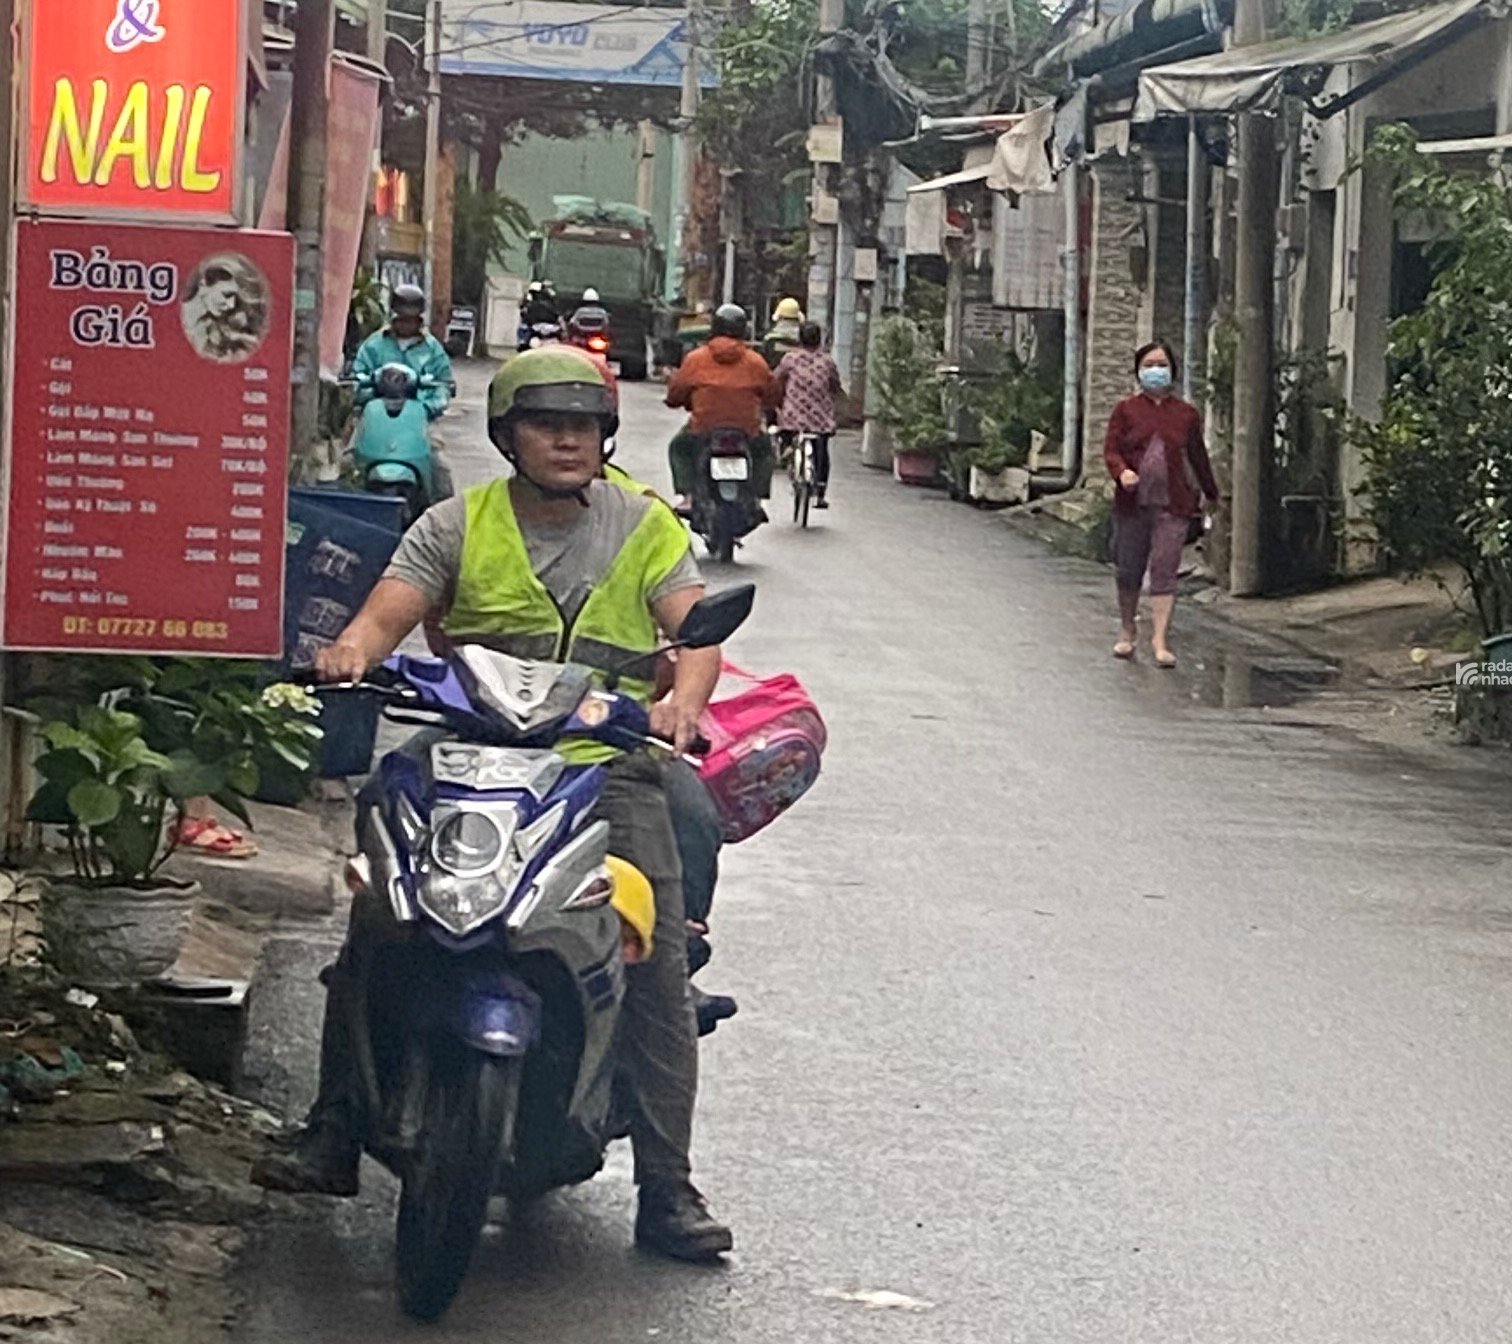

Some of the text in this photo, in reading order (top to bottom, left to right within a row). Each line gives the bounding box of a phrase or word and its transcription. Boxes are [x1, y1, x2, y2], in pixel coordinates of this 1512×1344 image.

[40, 78, 221, 193] NAIL
[49, 245, 178, 305] Bảng
[69, 301, 156, 348] Giá
